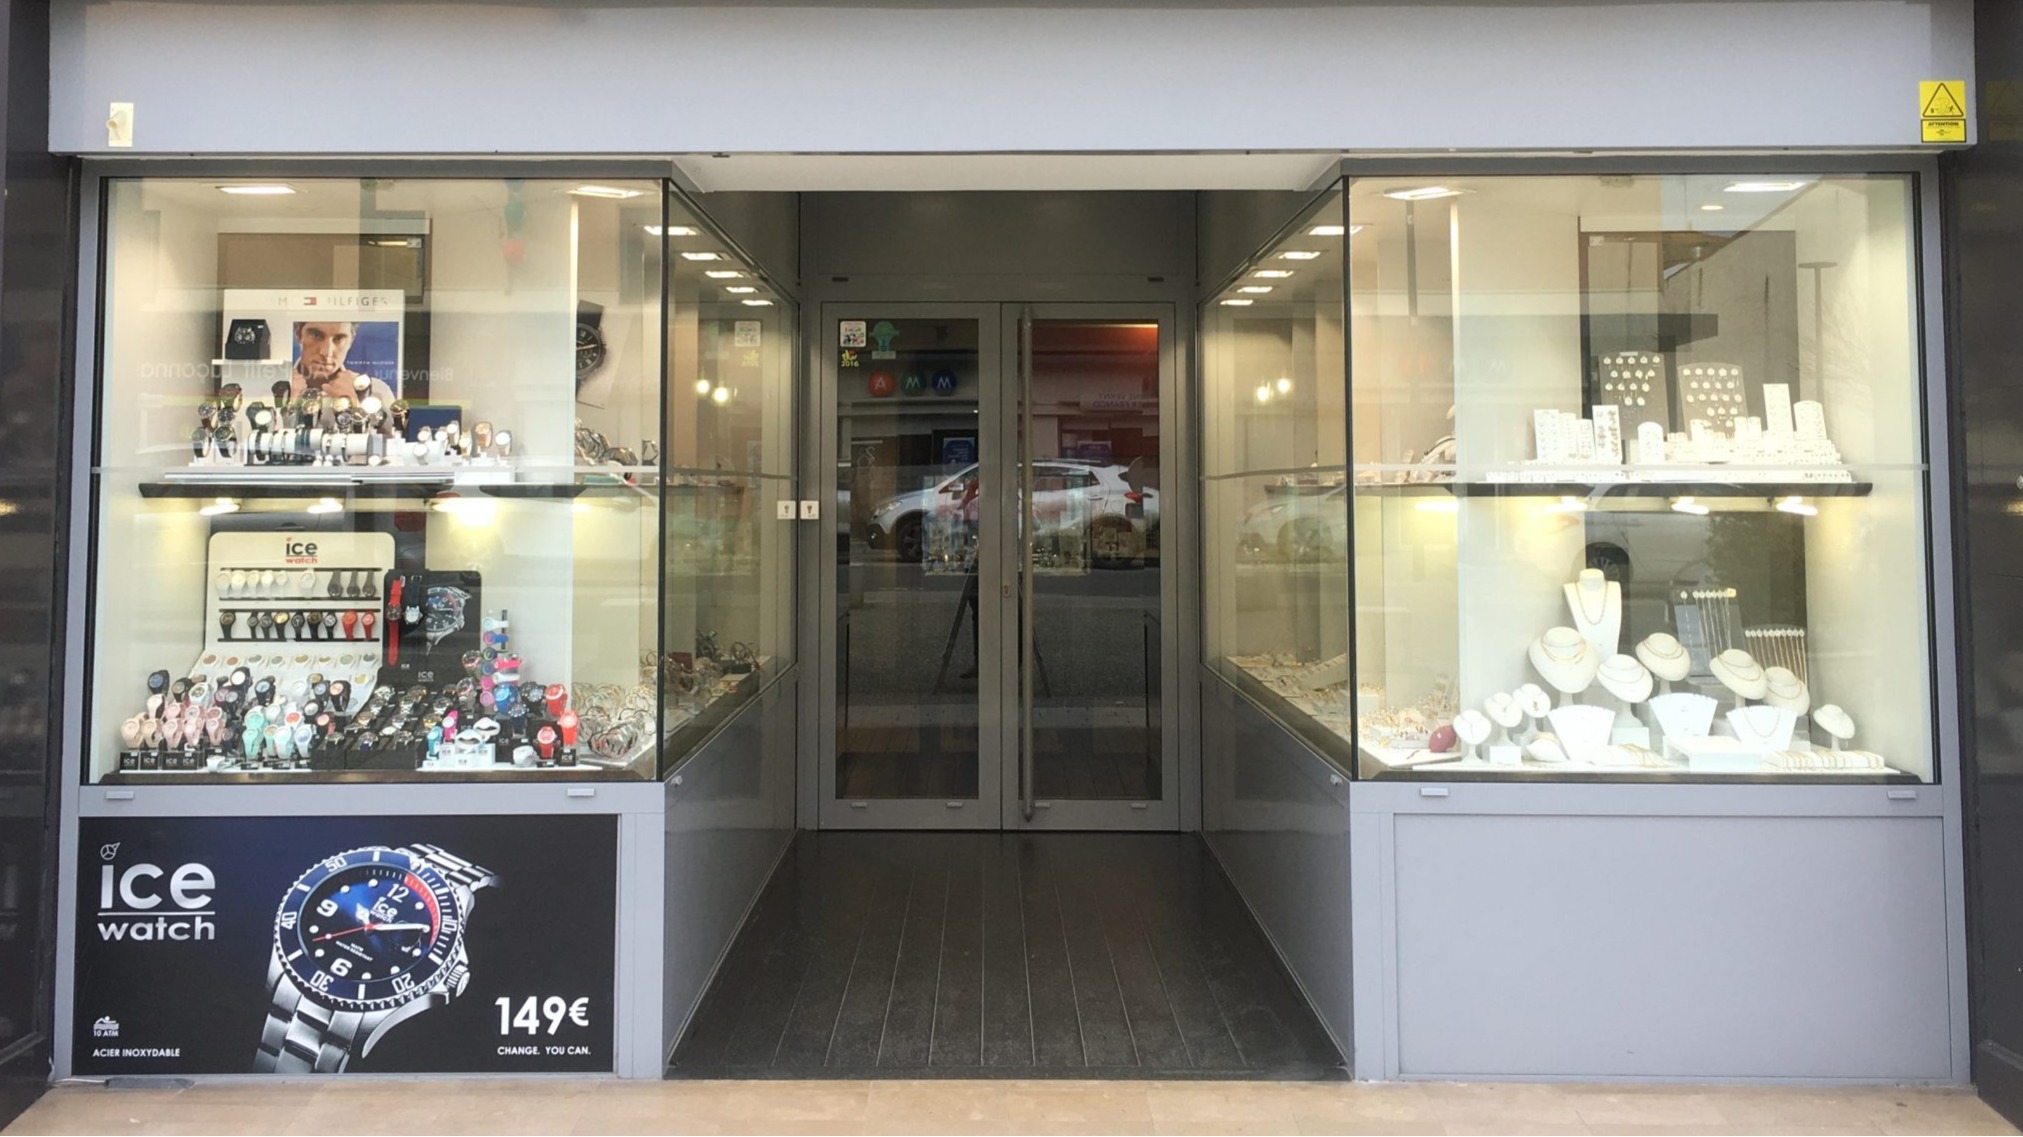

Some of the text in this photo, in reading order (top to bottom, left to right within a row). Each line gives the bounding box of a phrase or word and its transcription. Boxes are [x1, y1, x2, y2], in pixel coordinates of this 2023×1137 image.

[286, 536, 318, 555] ice
[325, 857, 348, 873] 50
[100, 842, 216, 910] ice
[387, 883, 409, 904] 12
[316, 898, 339, 918] 9
[97, 916, 216, 941] watch
[281, 911, 298, 930] 40
[330, 957, 353, 977] 6
[310, 969, 334, 992] 30
[392, 972, 415, 993] 20
[494, 995, 590, 1036] 149€
[92, 1048, 181, 1057] ACIER INOXYDABLE
[497, 1046, 592, 1055] CHANGE. YOU CAN.
